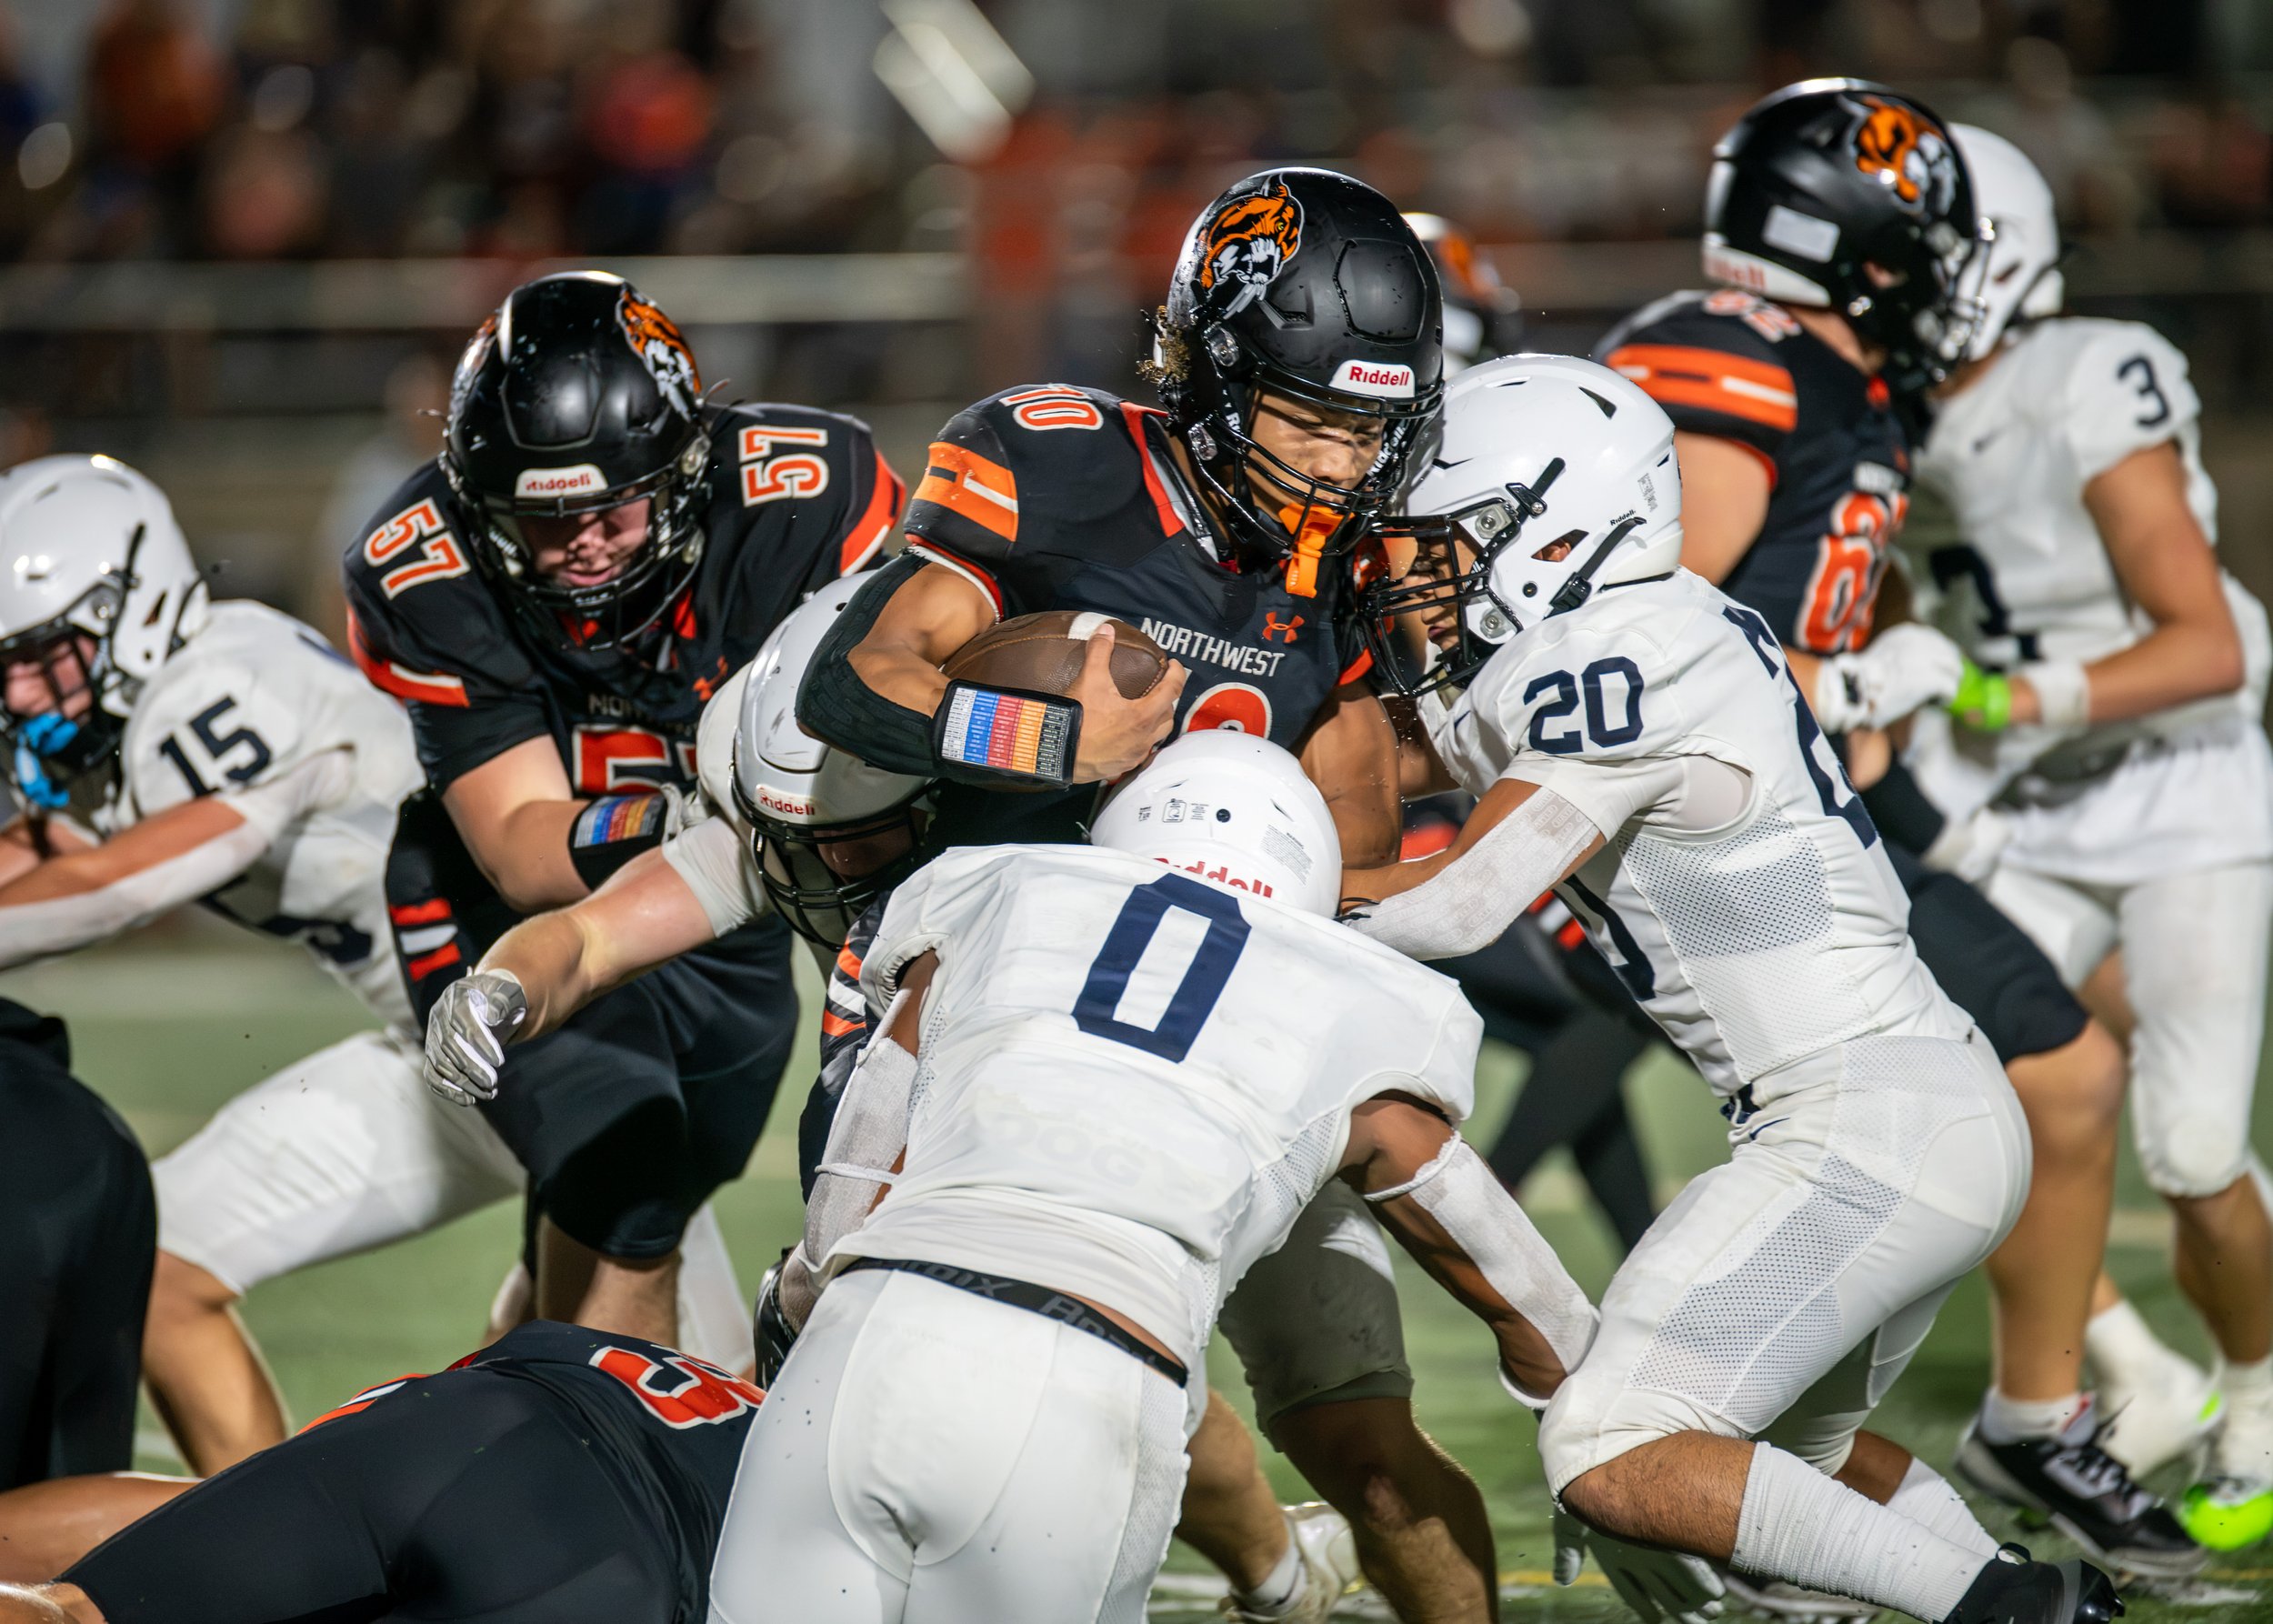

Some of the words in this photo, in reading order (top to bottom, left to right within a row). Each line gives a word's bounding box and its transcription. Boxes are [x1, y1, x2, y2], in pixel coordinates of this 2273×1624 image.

[999, 384, 1104, 431] 10
[1348, 366, 1410, 386] Riddell
[2117, 356, 2171, 428] 3
[738, 424, 829, 507] 57
[364, 496, 471, 601] 57
[1140, 617, 1286, 677] NORTHWEST
[159, 695, 271, 797] 15
[1523, 656, 1645, 755] 20
[1071, 871, 1252, 1064] 0
